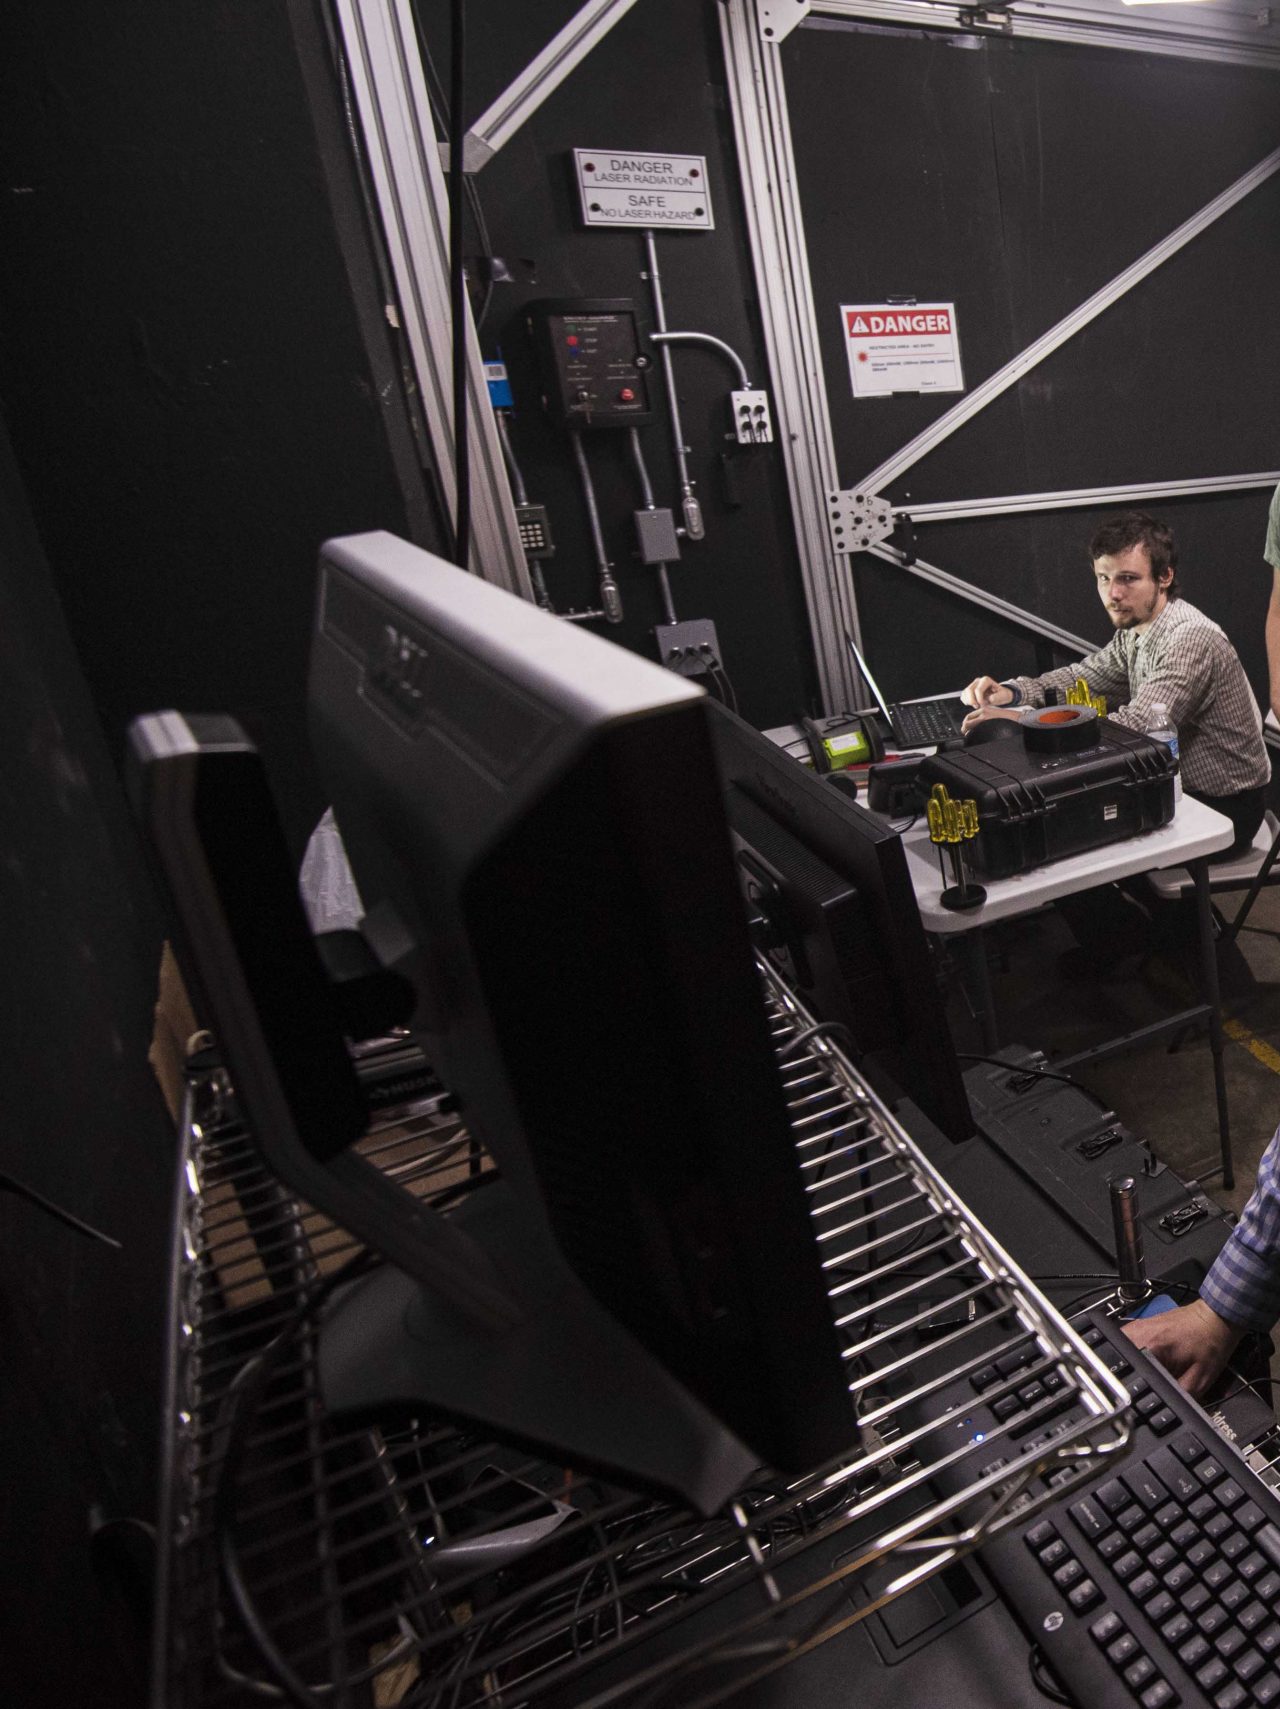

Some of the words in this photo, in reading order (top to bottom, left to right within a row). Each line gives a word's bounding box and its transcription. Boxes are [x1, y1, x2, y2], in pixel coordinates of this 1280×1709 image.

[610, 159, 673, 174] DANGER
[594, 173, 631, 183] LASER
[634, 175, 693, 186] RADIATION
[628, 195, 666, 207] SAFE
[600, 208, 616, 217] NO
[618, 209, 650, 218] LASER
[653, 211, 696, 220] HAZARD
[870, 314, 950, 334] DANGER
